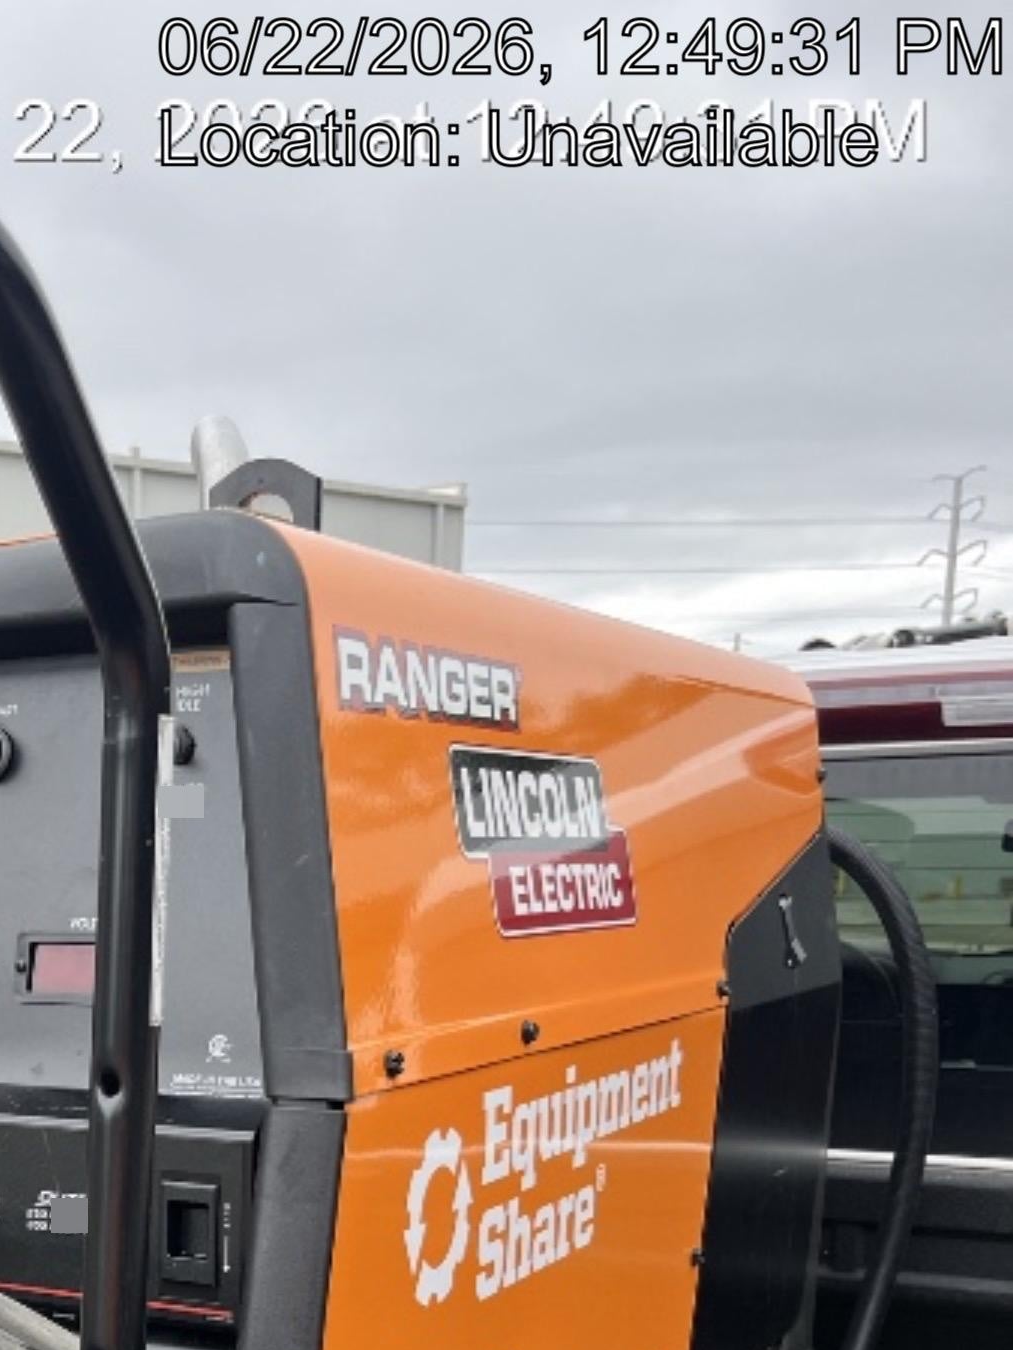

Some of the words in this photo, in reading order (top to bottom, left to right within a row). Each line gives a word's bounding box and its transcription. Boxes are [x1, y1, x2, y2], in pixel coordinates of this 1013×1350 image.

[337, 636, 519, 722] RANGER
[460, 766, 601, 839] LINCOLN
[508, 863, 622, 917] ELECTRIC
[481, 1037, 683, 1192] Equipment
